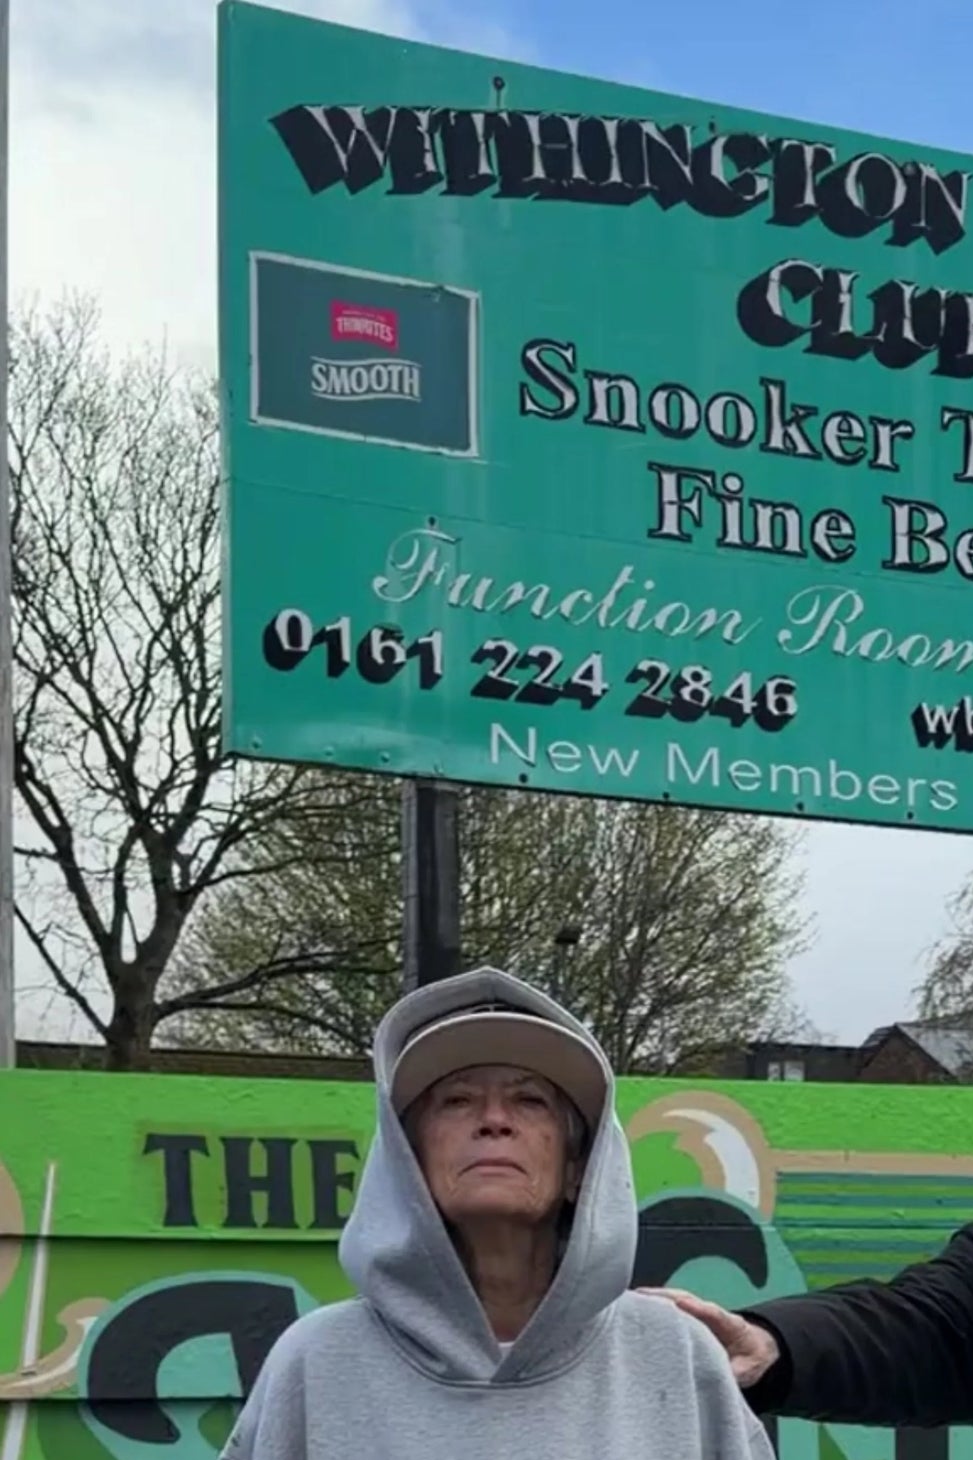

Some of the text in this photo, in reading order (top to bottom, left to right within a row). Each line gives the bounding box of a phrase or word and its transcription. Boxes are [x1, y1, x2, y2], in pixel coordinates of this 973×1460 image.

[268, 103, 973, 255] WITHINGTON
[336, 315, 394, 342] TTES
[311, 362, 420, 398] SMOOTH
[519, 338, 914, 471] Snooker
[648, 462, 856, 562] Fine
[371, 528, 763, 645] Function
[262, 607, 799, 732] 0161 224 2846
[489, 722, 640, 778] New
[666, 742, 959, 811] Members
[142, 1133, 360, 1229] THE
